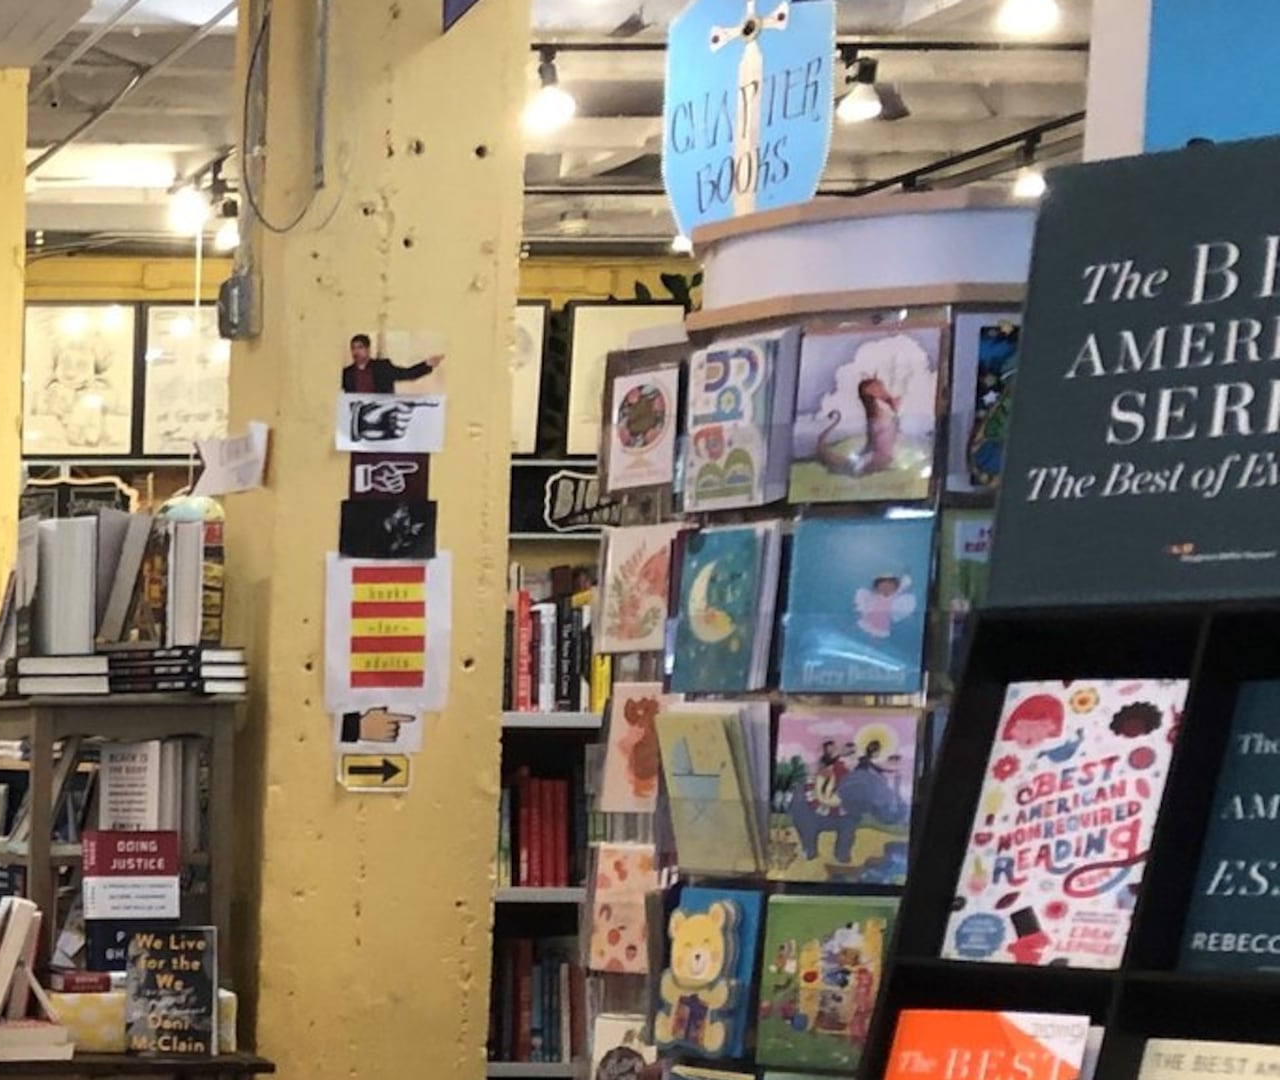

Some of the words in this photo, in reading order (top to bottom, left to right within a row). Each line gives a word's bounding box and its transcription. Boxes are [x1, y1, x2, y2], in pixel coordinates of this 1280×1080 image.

[671, 56, 823, 154] CHAPTER
[696, 136, 789, 214] BOOKS
[1082, 258, 1169, 305] The
[1027, 465, 1096, 501] The
[1101, 460, 1184, 499] Best
[1192, 453, 1237, 499] of
[1016, 755, 1119, 806] BEST
[1015, 778, 1128, 826] AMERICAN
[997, 801, 1142, 854] NONREQUIRED
[116, 840, 159, 853] DOING
[110, 857, 166, 871] JUSTICE
[135, 932, 164, 950] We
[169, 933, 207, 951] Live
[140, 954, 164, 971] for
[172, 954, 202, 971] the
[155, 973, 185, 992] We
[131, 1036, 206, 1054] McClain
[898, 1050, 938, 1074] The
[1153, 1052, 1186, 1071] THE
[1191, 1054, 1249, 1075] BEST
